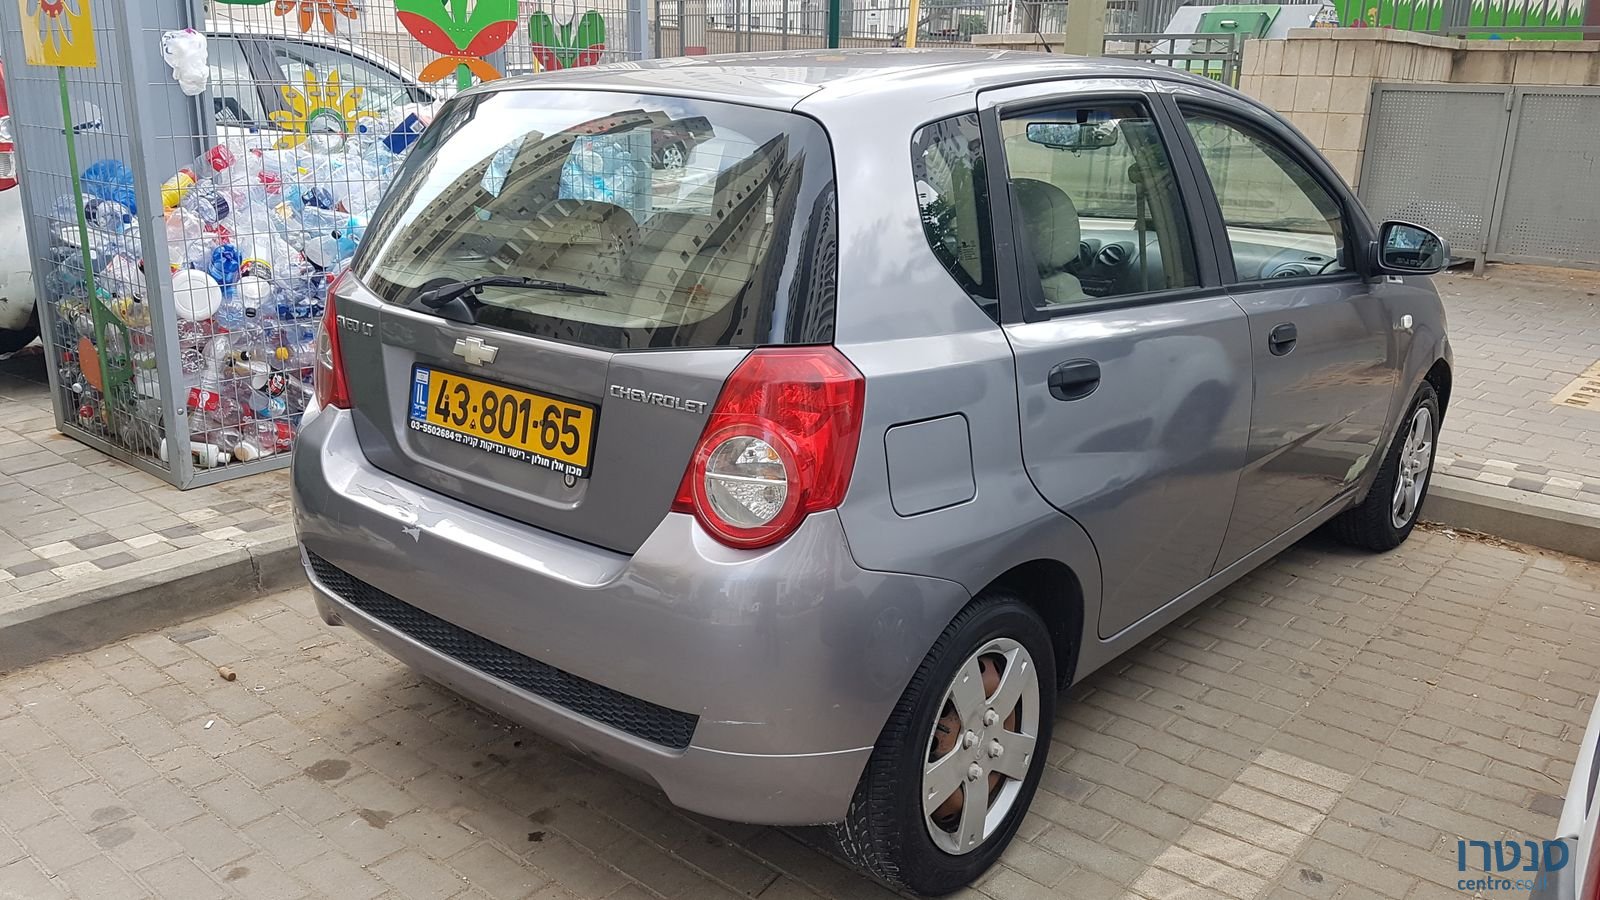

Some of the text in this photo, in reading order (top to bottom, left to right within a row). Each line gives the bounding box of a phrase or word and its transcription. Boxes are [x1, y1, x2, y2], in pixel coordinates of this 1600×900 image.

[362, 322, 374, 337] LT
[416, 383, 426, 405] IL
[610, 384, 708, 414] CHEVROLET
[410, 420, 455, 441] 03-5502684
[462, 435, 479, 448] קניה
[479, 439, 506, 456] ובדיקות
[507, 448, 526, 461] רישוי
[531, 453, 550, 467] חולון
[551, 458, 564, 471] אלן
[565, 464, 582, 477] מכון
